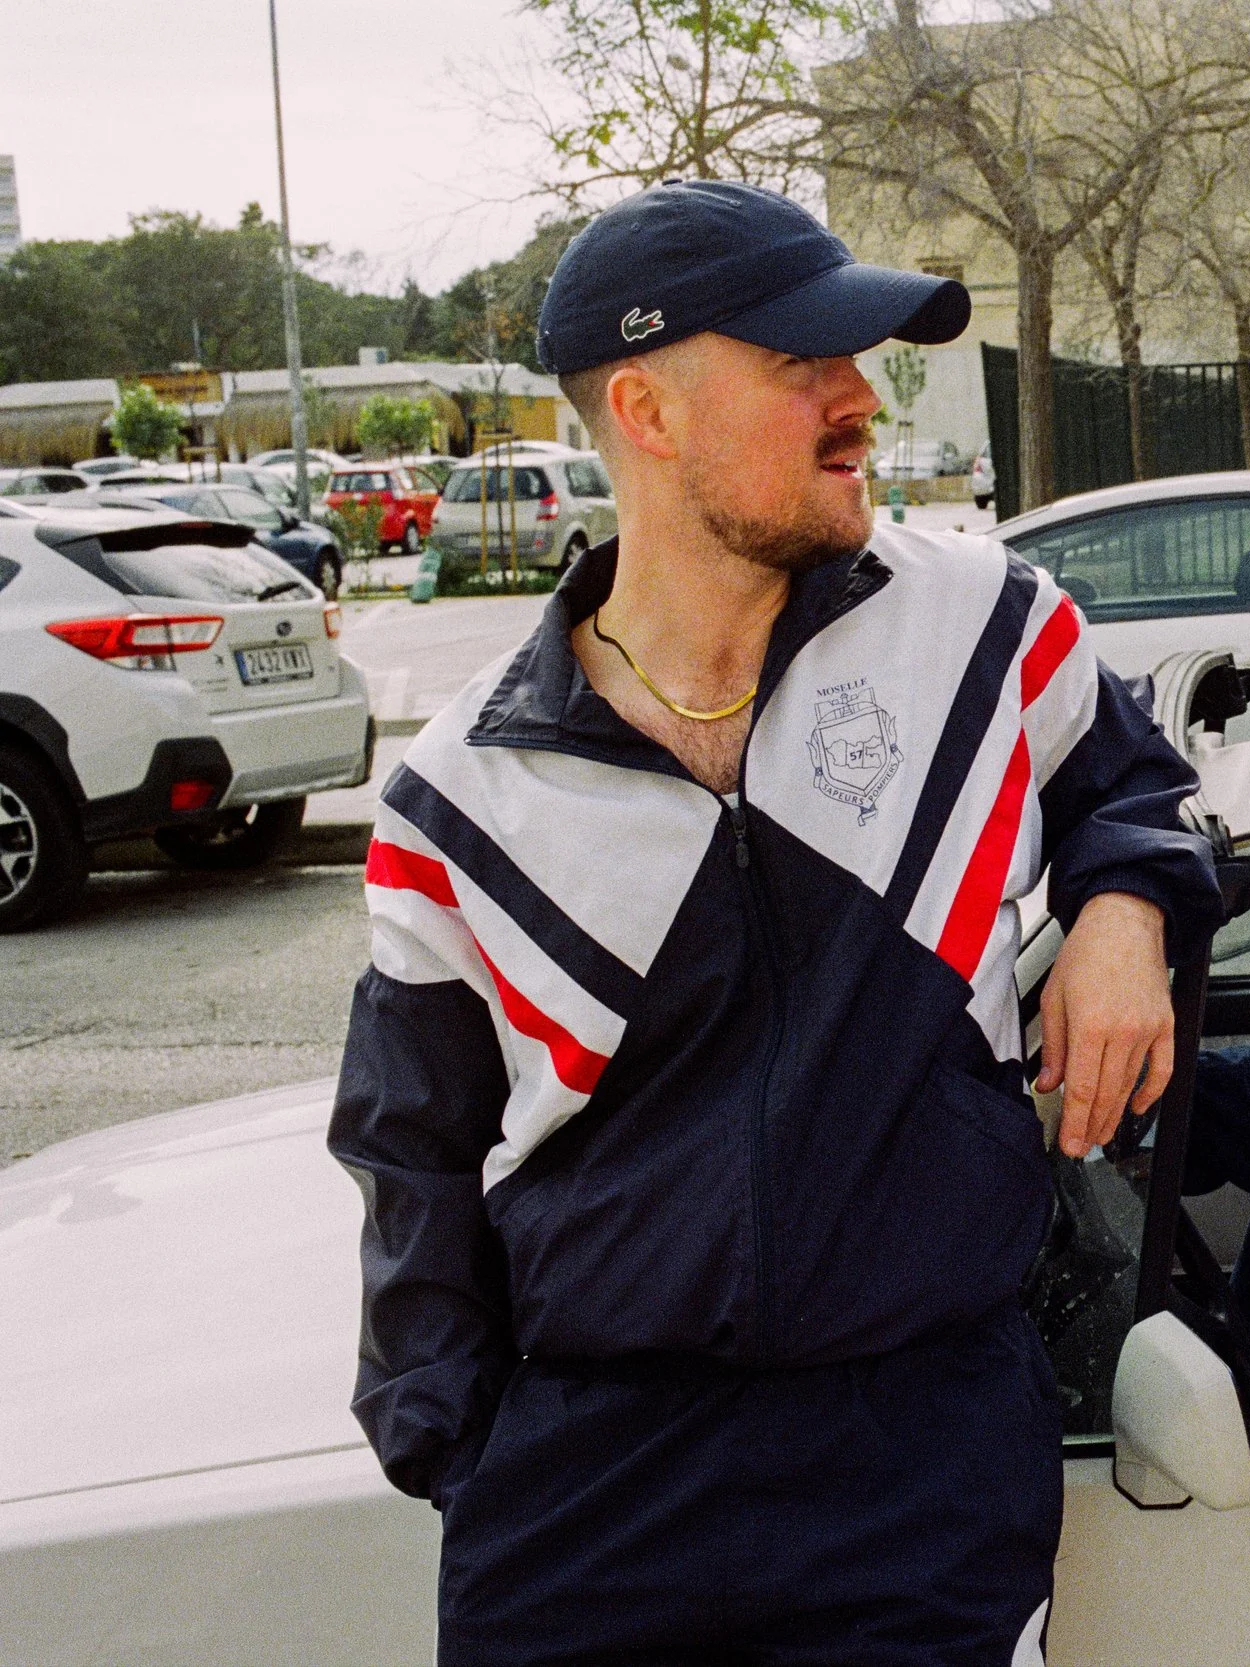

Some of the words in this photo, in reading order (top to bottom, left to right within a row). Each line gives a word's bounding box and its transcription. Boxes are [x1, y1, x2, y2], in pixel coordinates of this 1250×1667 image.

[816, 677, 868, 697] MOSELLE
[849, 750, 864, 761] 57
[821, 783, 865, 806] SAPEURS
[868, 761, 899, 802] POMPIERS
